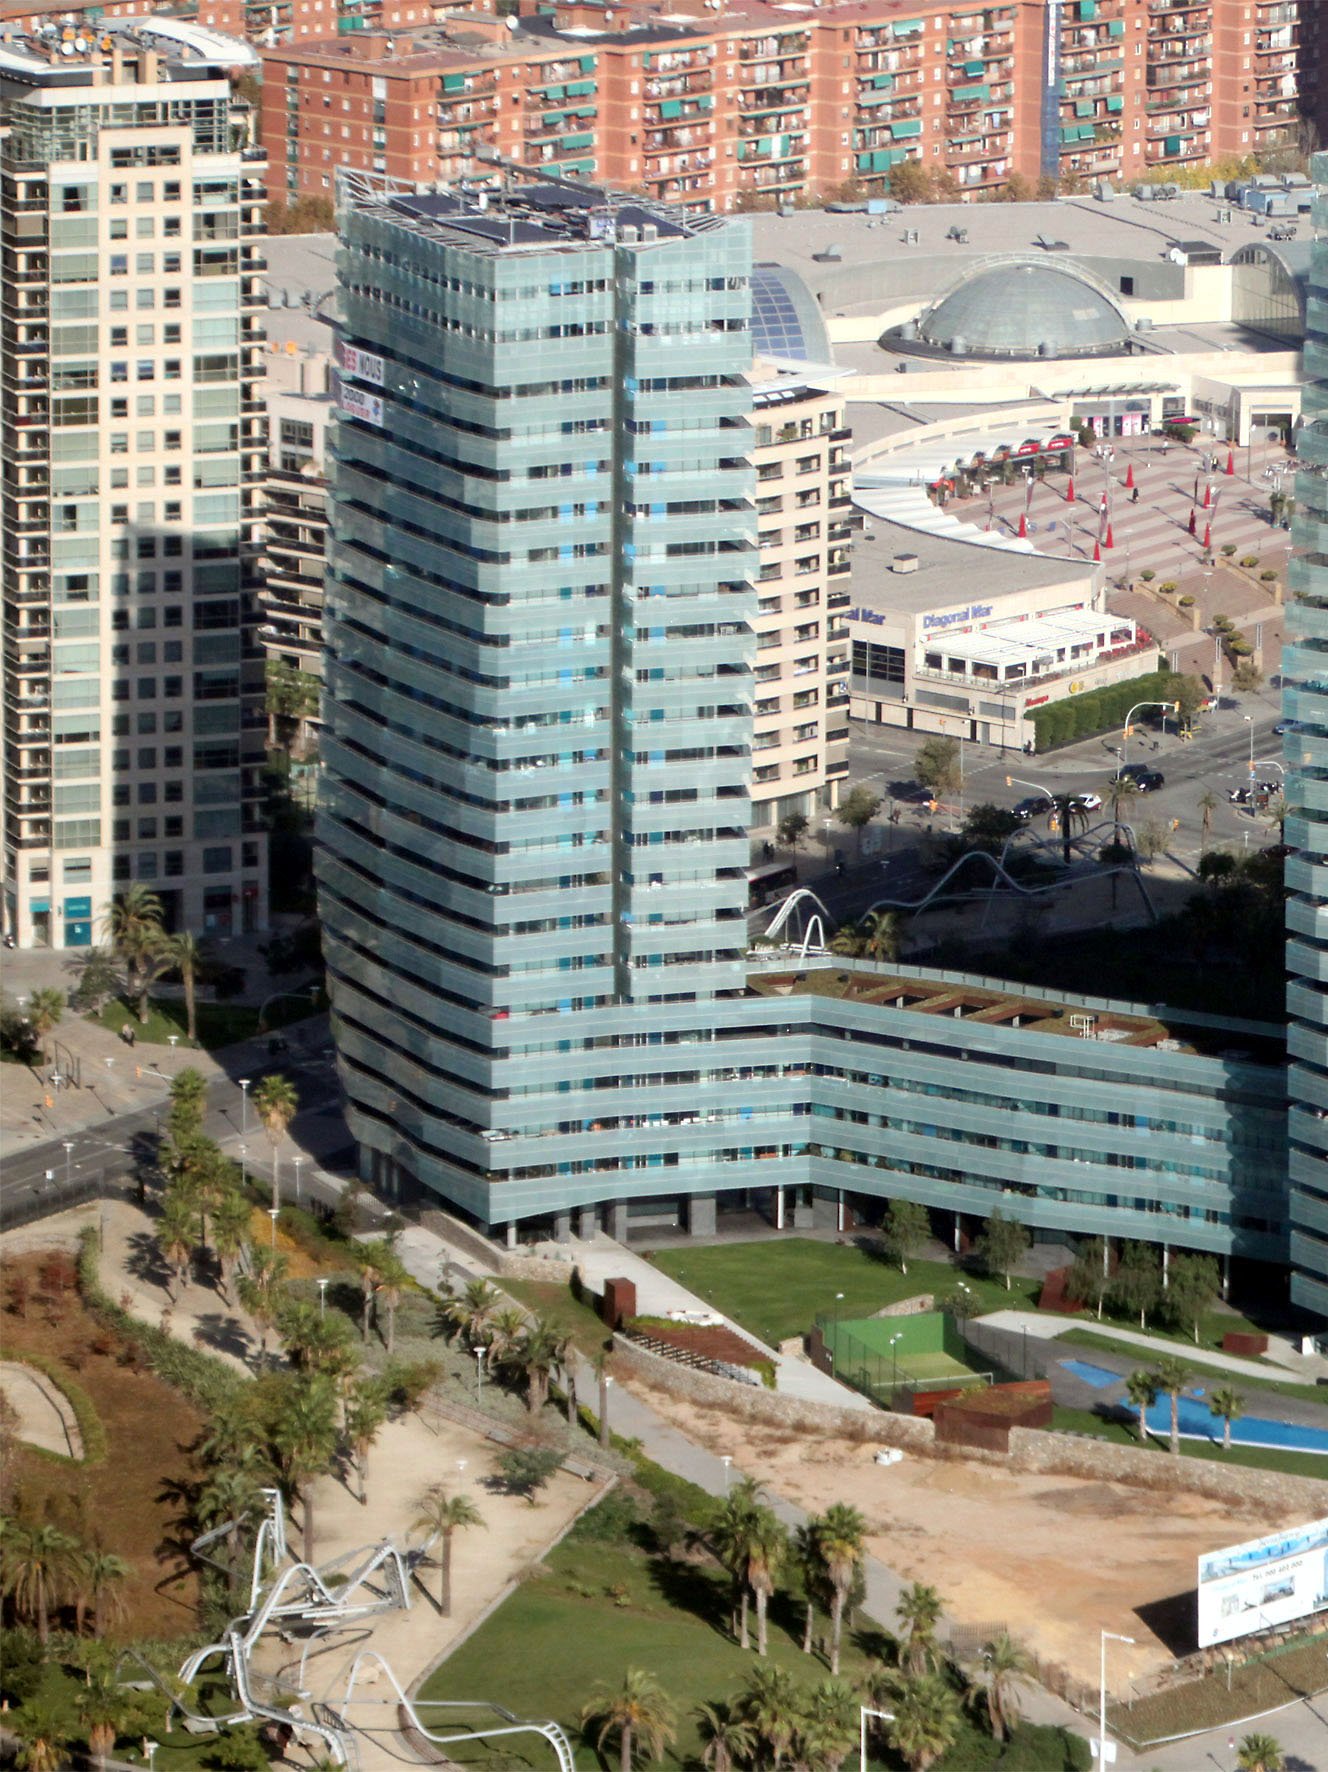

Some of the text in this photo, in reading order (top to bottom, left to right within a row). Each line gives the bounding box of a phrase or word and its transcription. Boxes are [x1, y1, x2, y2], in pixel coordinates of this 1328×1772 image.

[359, 354, 382, 381] NOUS
[861, 607, 886, 625] Mar
[922, 604, 993, 629] Diagonal Mar
